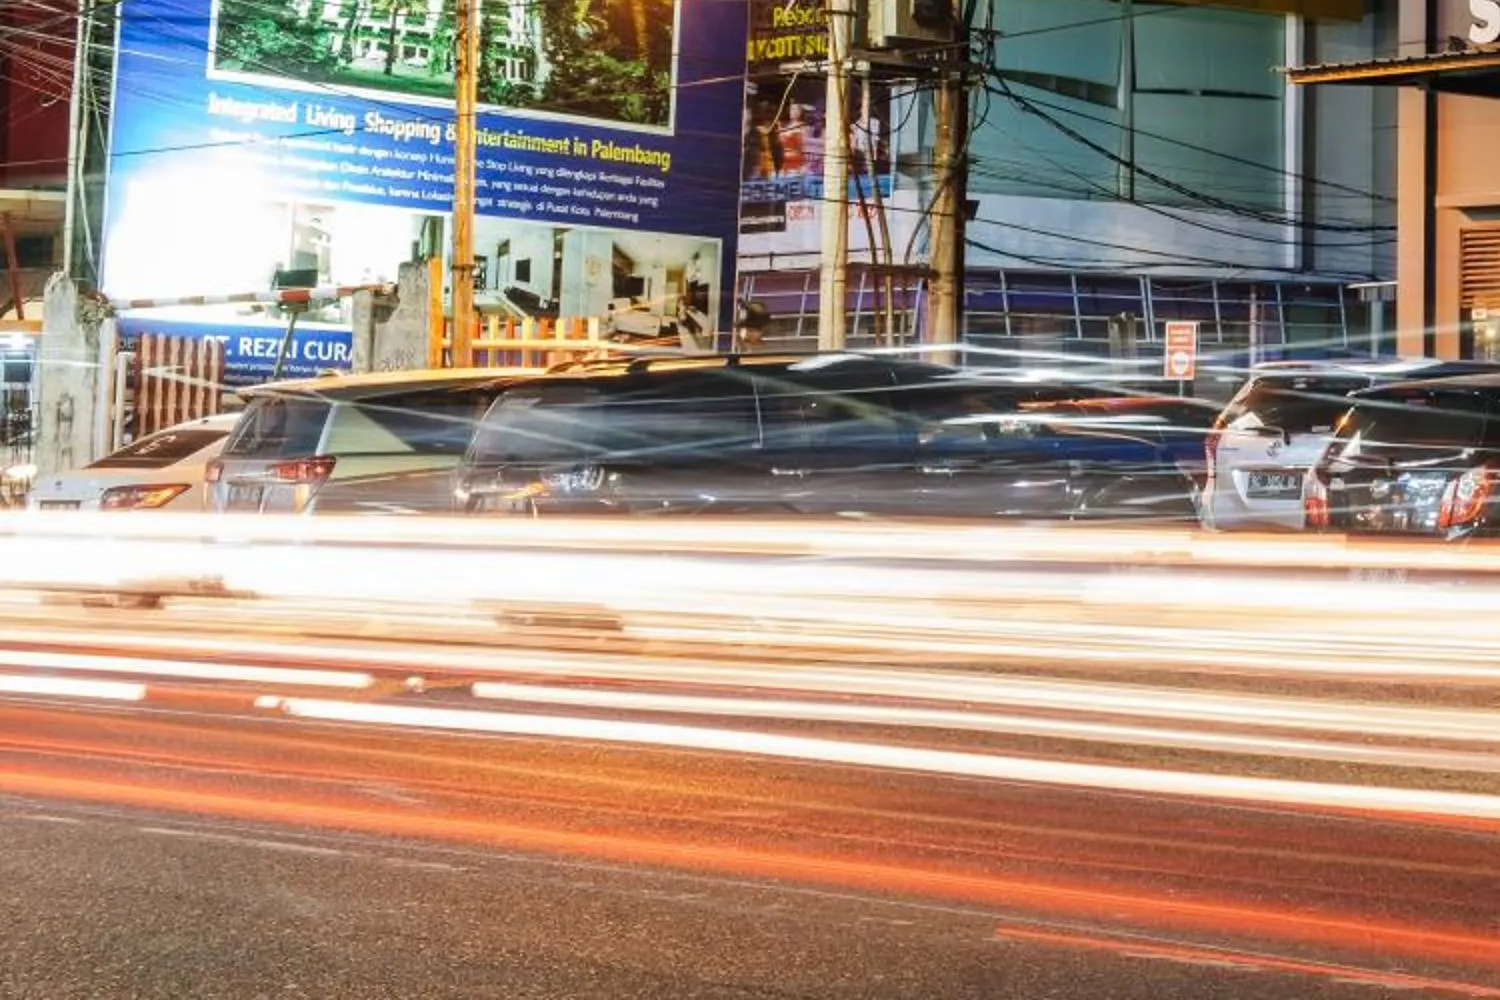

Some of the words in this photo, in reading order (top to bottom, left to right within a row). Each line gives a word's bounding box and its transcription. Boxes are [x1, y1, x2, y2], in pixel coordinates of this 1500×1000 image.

[208, 91, 298, 125] Integrated
[306, 103, 355, 136] Living
[364, 111, 441, 145] Shopping
[472, 127, 570, 155] ntertainment
[573, 136, 587, 156] in
[591, 139, 671, 172] Palembang
